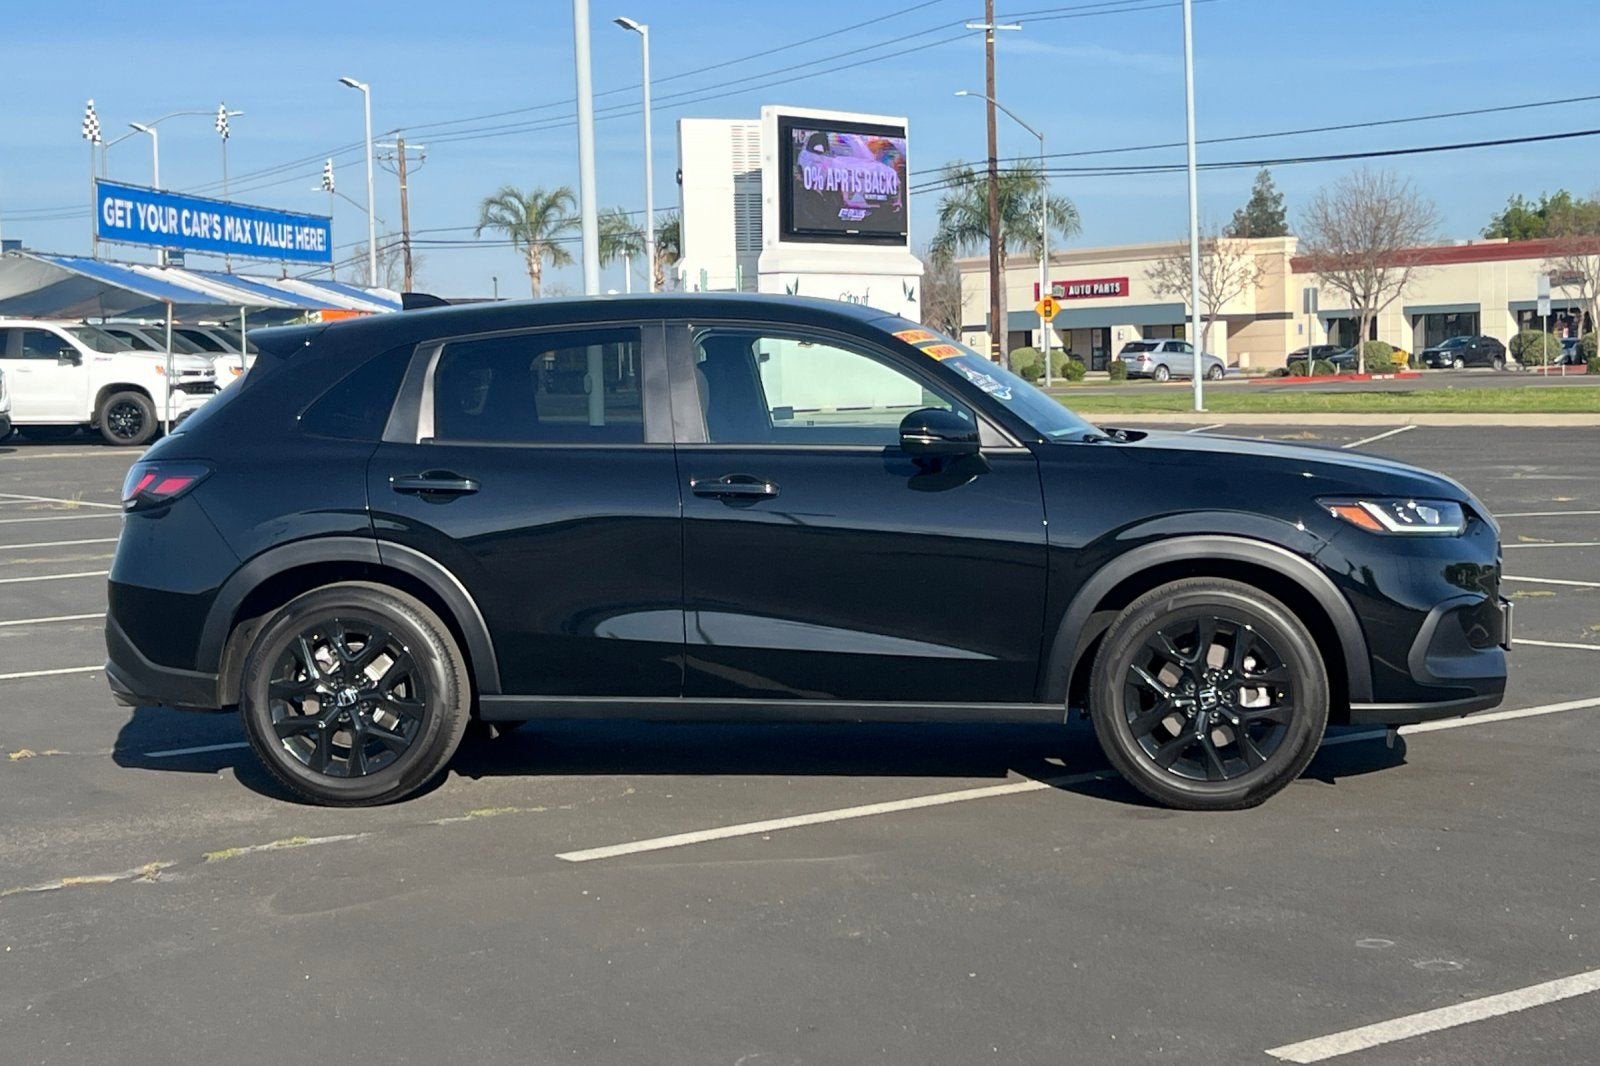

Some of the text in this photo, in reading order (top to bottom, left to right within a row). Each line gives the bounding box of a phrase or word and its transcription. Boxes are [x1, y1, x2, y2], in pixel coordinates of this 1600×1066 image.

[803, 166, 898, 195] 0% APR IS BACK!
[103, 197, 327, 251] GET YOUR CAR'S MAX VALUE HERE!
[1068, 284, 1092, 296] AUTO
[1093, 282, 1121, 295] PARTS
